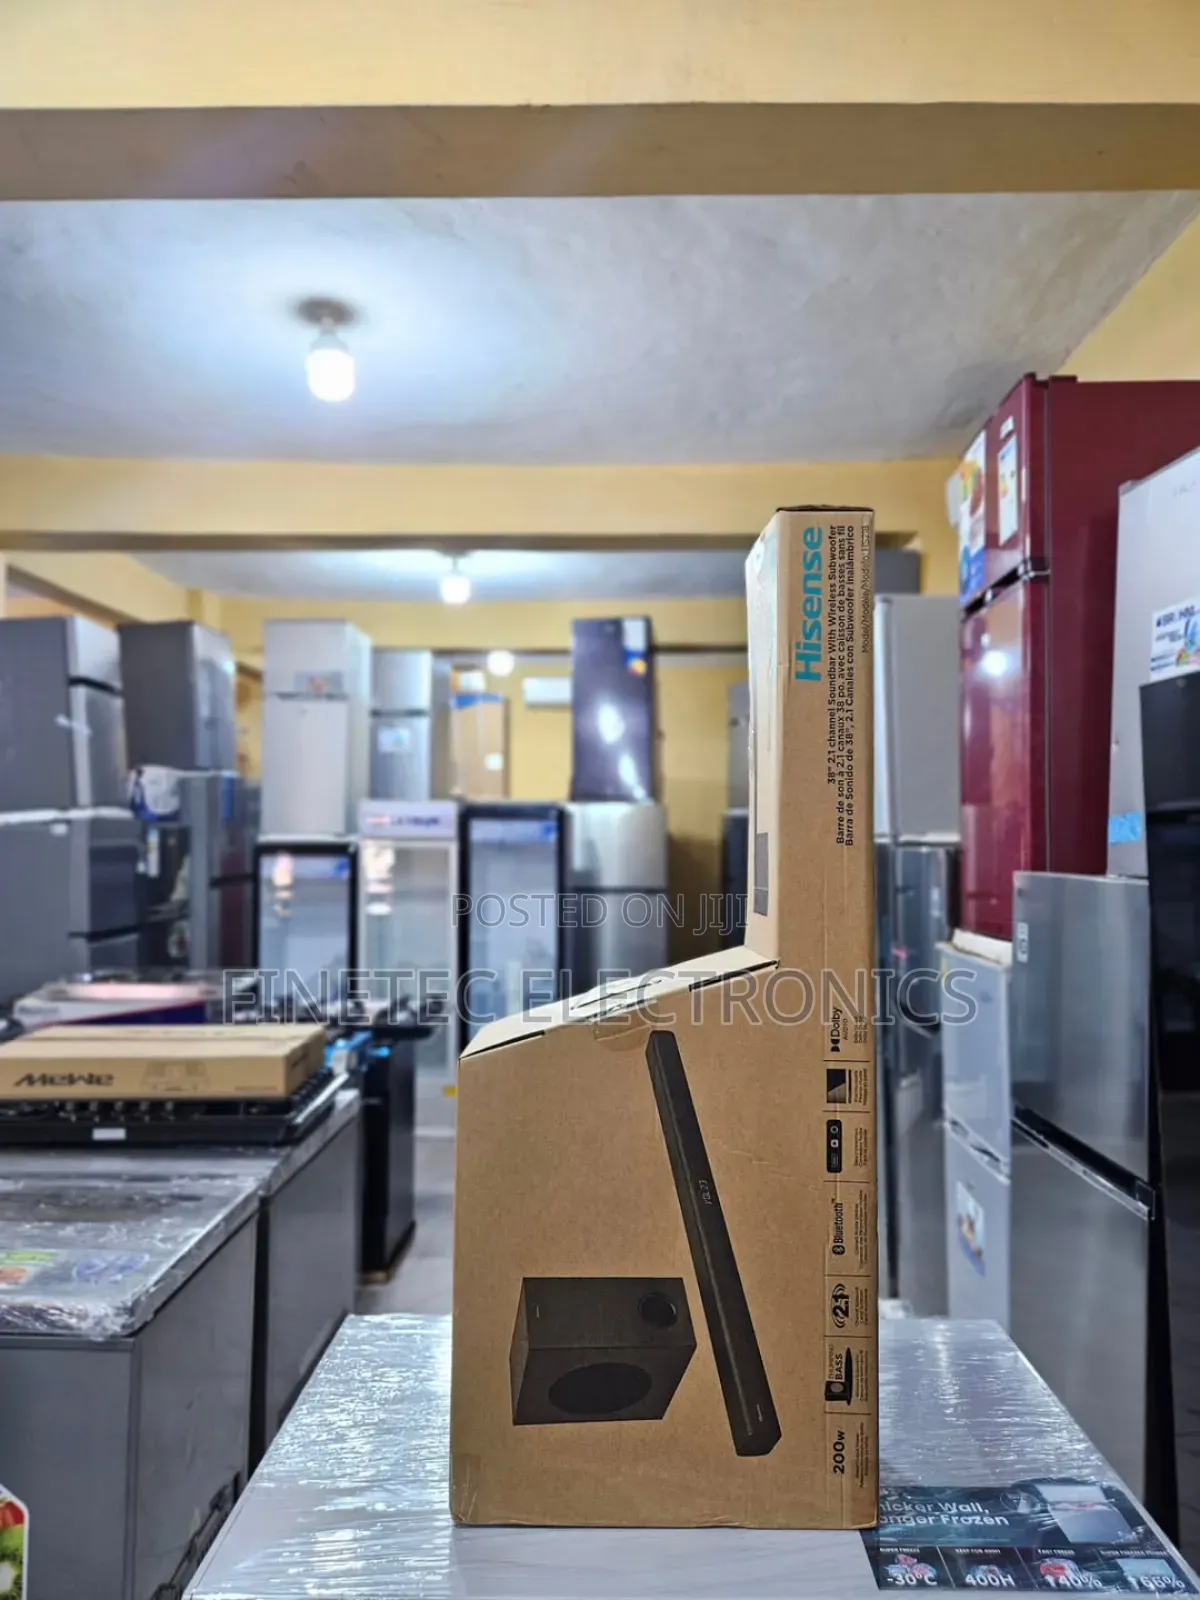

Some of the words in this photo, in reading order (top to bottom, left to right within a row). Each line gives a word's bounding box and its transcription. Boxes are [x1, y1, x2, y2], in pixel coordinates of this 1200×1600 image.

[836, 525, 846, 536] fil
[828, 525, 837, 581] Subwoofer
[838, 538, 846, 561] sans
[837, 563, 846, 597] basses
[795, 527, 823, 681] Hisense
[828, 583, 837, 627] Wireless
[837, 599, 846, 612] de
[845, 588, 854, 642] Subwoofer
[828, 629, 837, 654] With
[837, 615, 846, 652] caisson
[838, 655, 846, 679] avec
[828, 656, 837, 706] Soundbar
[838, 682, 847, 698] po.
[845, 666, 854, 706] Canales
[837, 701, 845, 713] 38
[845, 708, 854, 722] 2.1
[828, 708, 837, 748] channel
[828, 750, 837, 764] 2.1
[837, 754, 845, 768] 2.1
[845, 748, 854, 762] de
[845, 764, 854, 800] Sonido
[836, 800, 845, 813] de
[845, 803, 854, 816] de
[836, 816, 845, 845] Barre
[845, 818, 854, 846] Barra
[830, 1007, 843, 1037] Dolby
[833, 1202, 844, 1244] Bluetooth
[832, 1294, 850, 1318] 2.1
[835, 1353, 843, 1381] BASS
[938, 1502, 990, 1515] Wall,
[940, 1514, 1010, 1526] Frozen
[964, 1574, 1016, 1587] 400H
